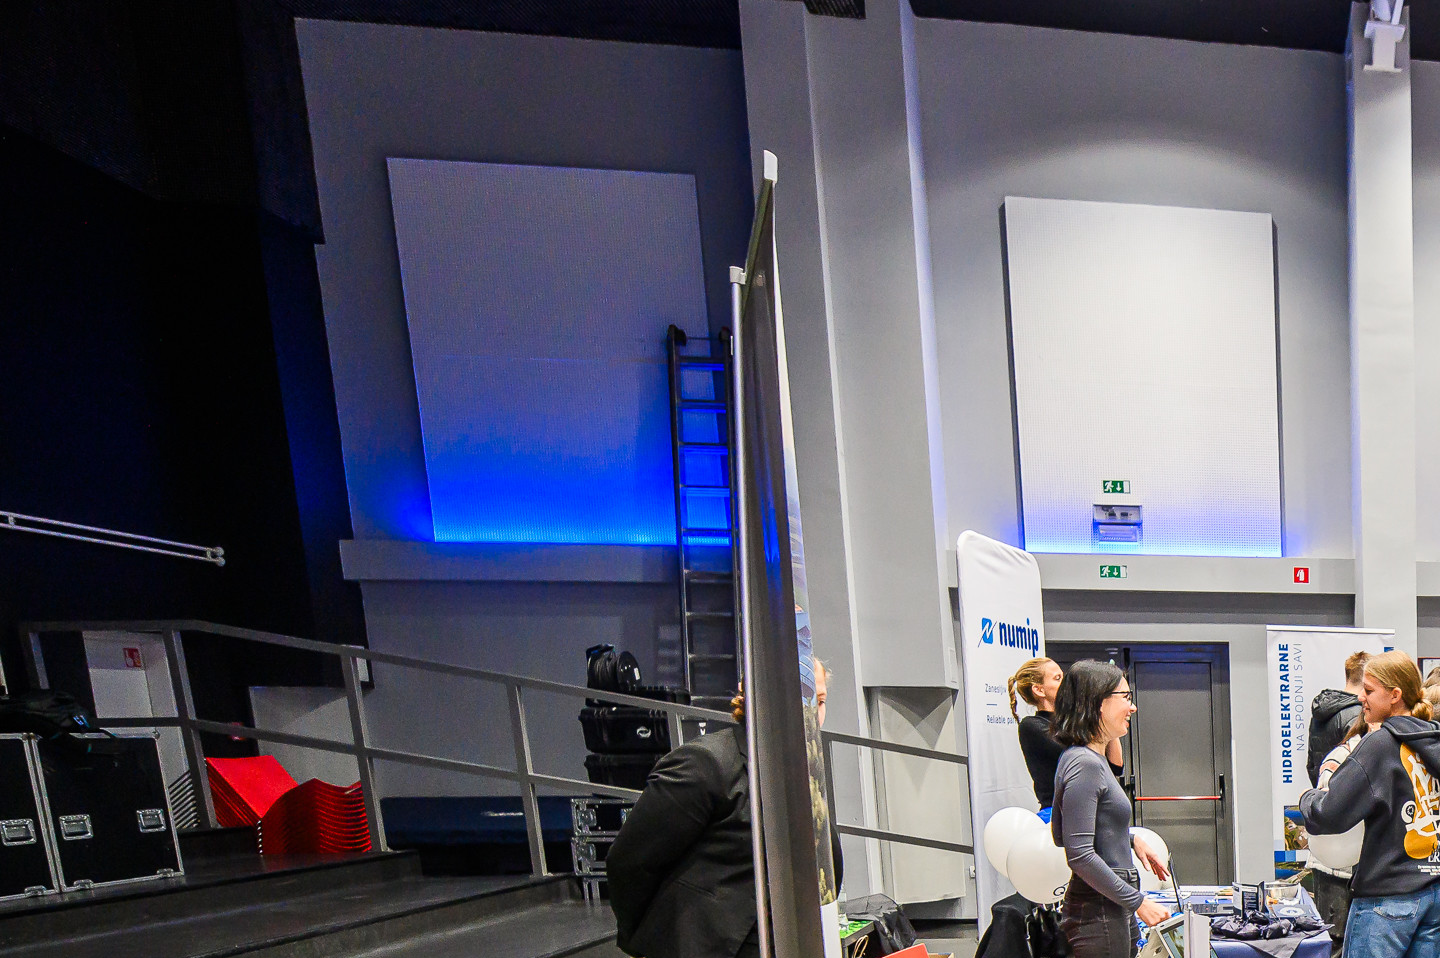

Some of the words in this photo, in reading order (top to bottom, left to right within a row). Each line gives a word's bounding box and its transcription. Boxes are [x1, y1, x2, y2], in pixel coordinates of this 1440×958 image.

[998, 617, 1039, 658] numip
[1293, 643, 1304, 671] SAVI
[1278, 643, 1293, 784] HIDROELEKTRARNE
[1294, 675, 1305, 729] SPODNJI
[1296, 736, 1306, 752] NA
